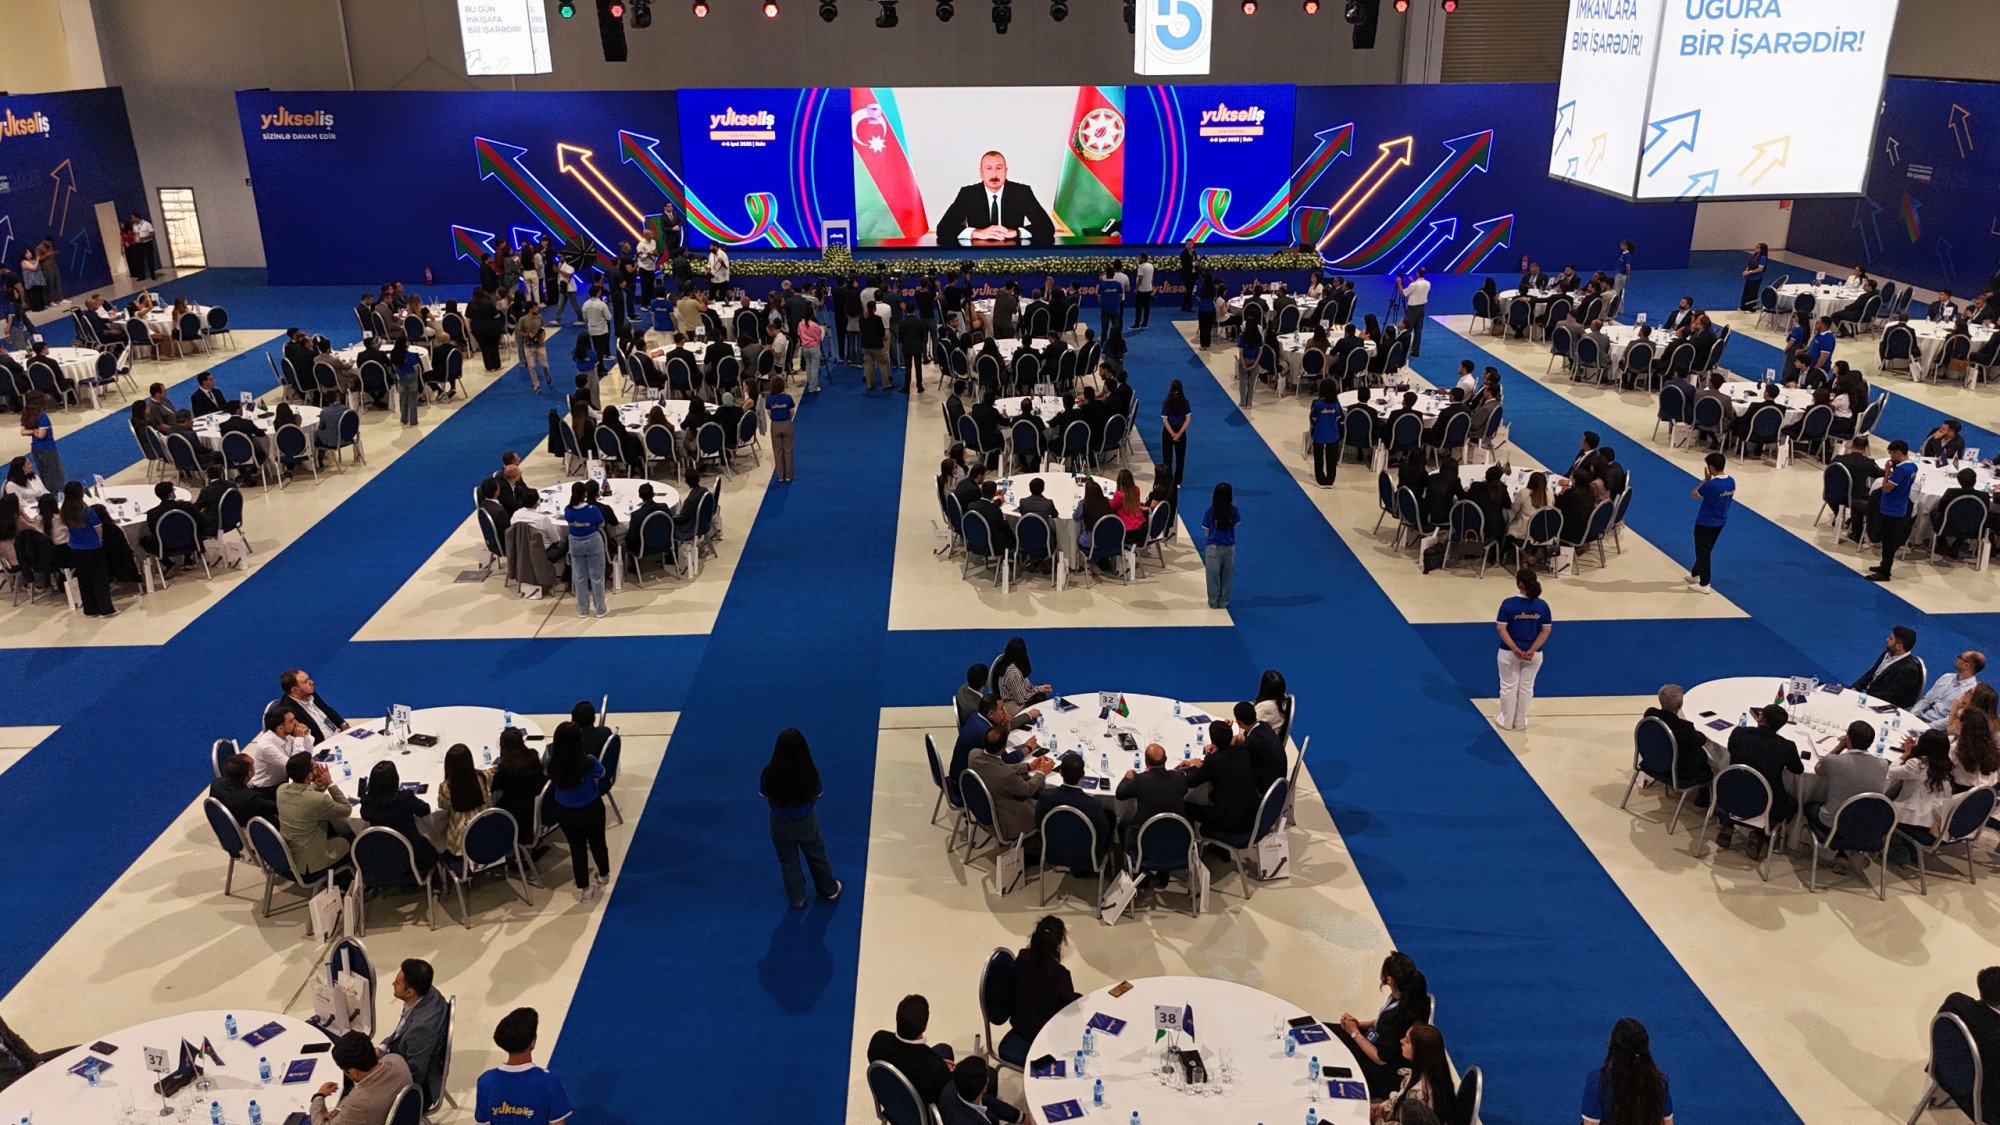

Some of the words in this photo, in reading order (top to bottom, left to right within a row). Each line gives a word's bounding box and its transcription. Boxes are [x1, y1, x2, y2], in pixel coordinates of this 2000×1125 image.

[1572, 27, 1589, 52] BİR
[1590, 27, 1644, 56] İŞARƏDİR!
[1680, 28, 1725, 56] BİR
[1730, 26, 1866, 59] İŞARƏDİR!
[292, 132, 318, 140] DAVAM
[1794, 682, 1807, 691] 33
[1102, 696, 1114, 704] 32
[397, 710, 406, 719] 31
[1159, 1012, 1177, 1024] 38
[148, 1054, 163, 1066] 37
